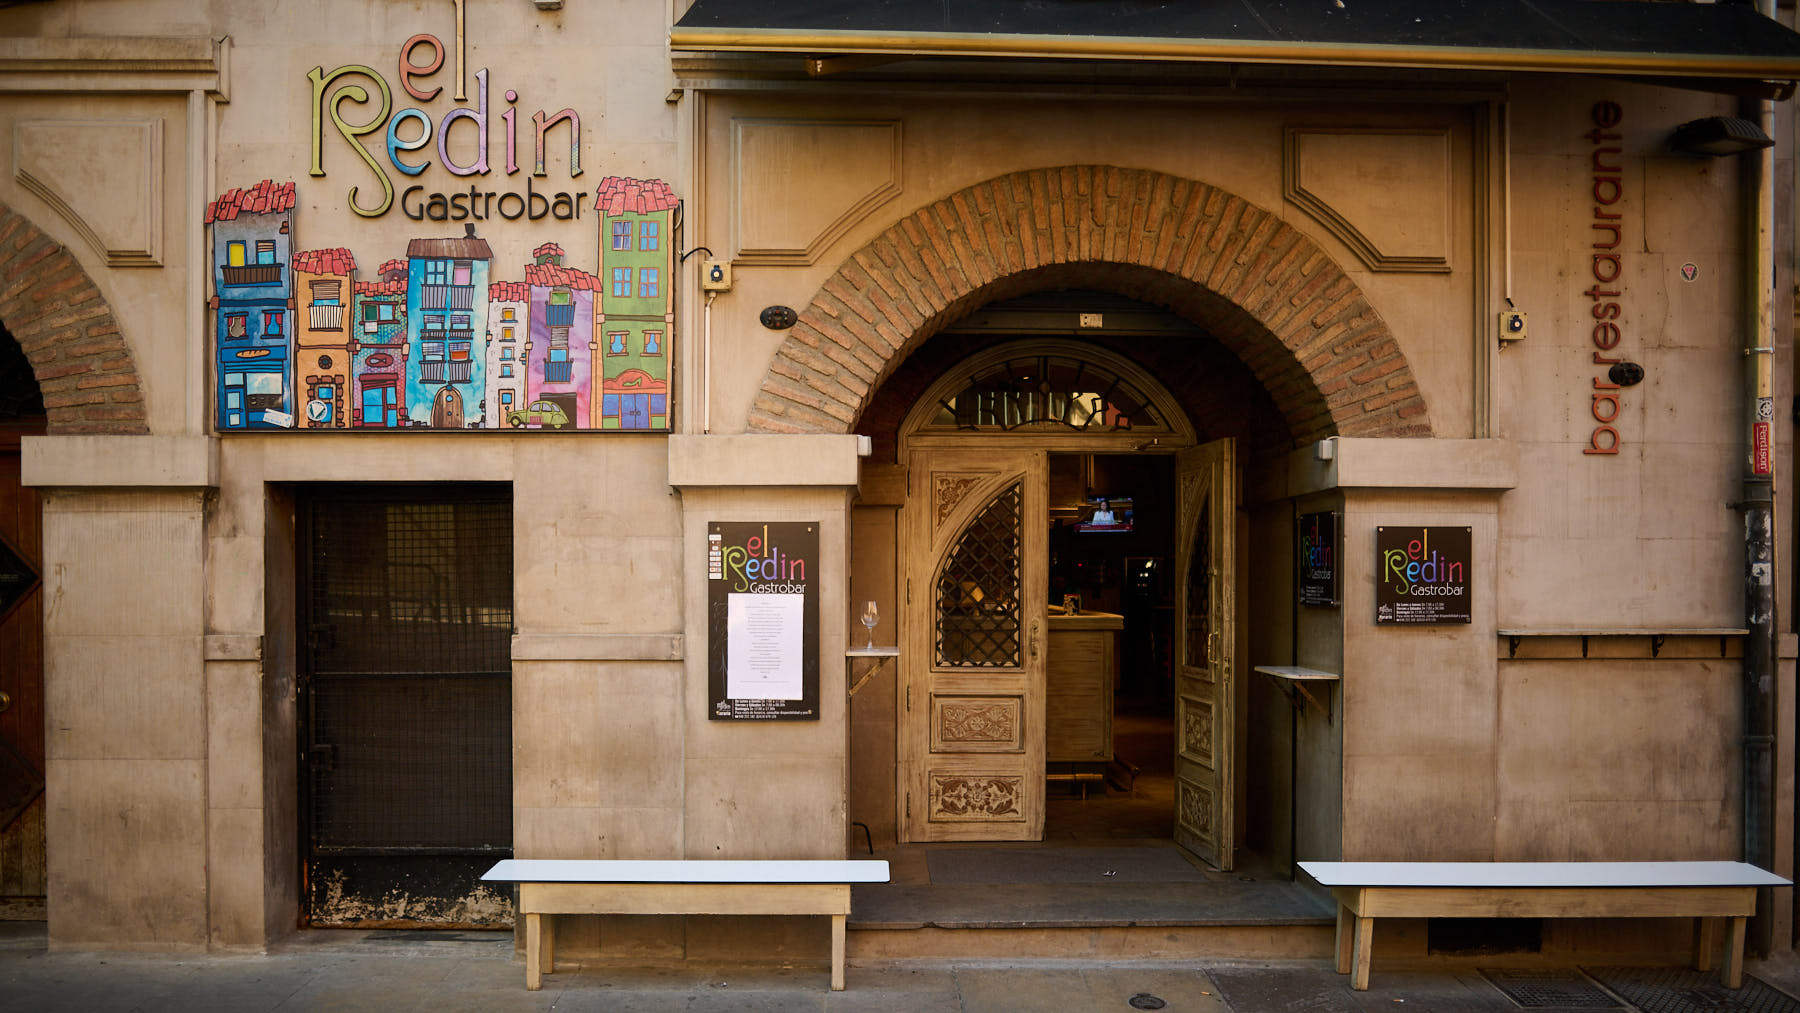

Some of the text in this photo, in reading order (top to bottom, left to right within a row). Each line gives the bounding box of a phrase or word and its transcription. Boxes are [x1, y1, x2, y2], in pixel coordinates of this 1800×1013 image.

[399, 0, 467, 102] el
[307, 65, 586, 217] Redin
[401, 177, 588, 221] Gastrobar
[1584, 99, 1624, 364] restaurante
[1583, 376, 1621, 455] bar
[746, 524, 769, 558] el
[1302, 535, 1332, 578] Redin
[1407, 528, 1428, 560] el
[722, 545, 805, 593] Redin
[750, 581, 806, 594] Gastrobar
[1383, 549, 1463, 595] Redin
[1410, 583, 1465, 596] Gastrobar
